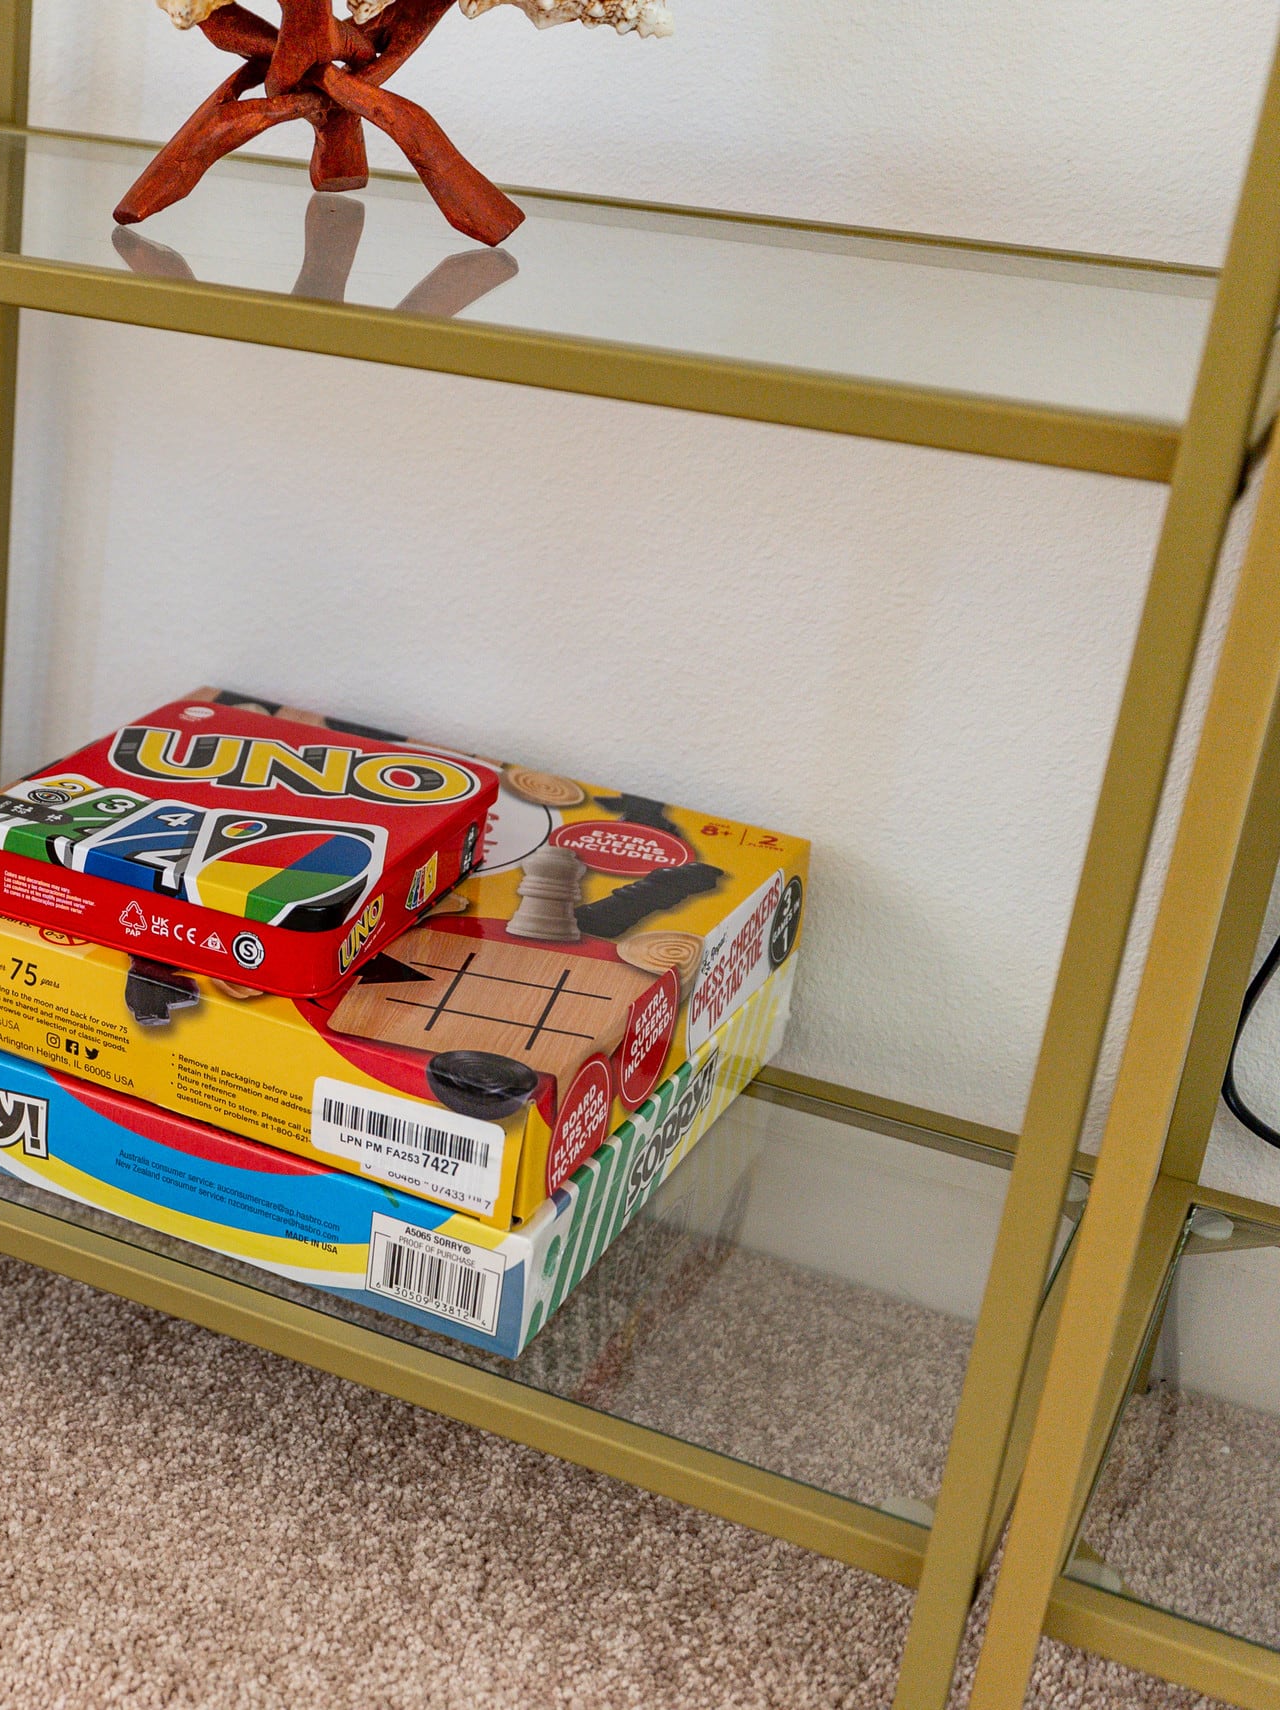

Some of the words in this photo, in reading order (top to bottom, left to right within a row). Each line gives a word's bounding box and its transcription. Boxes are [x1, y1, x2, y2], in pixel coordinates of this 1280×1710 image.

[107, 726, 481, 806] UNO
[579, 834, 666, 857] QUEENS
[590, 829, 659, 849] EXTRA
[700, 824, 733, 837] 8+
[757, 835, 779, 846] 2
[562, 838, 677, 865] INCLUDED!
[783, 886, 793, 917] 3
[125, 927, 141, 937] PAP
[151, 925, 169, 937] CA
[152, 915, 169, 928] UK
[339, 893, 384, 975] UNO
[772, 908, 793, 944] GAMES
[691, 877, 781, 1026] CHESS-CHECKERS
[10, 957, 38, 987] 75
[706, 928, 765, 1033] TIC-TAC-TOE
[2, 994, 14, 1005] are
[15, 998, 39, 1014] shared
[39, 1006, 53, 1018] and
[54, 1012, 95, 1033] memorable
[96, 1025, 130, 1045] moments
[20, 991, 32, 1002] the
[33, 997, 54, 1010] moon
[55, 1003, 69, 1015] and
[70, 1008, 87, 1021] back
[89, 1014, 100, 1025] for
[101, 1020, 117, 1031] over
[119, 1025, 128, 1034] 75
[630, 998, 669, 1057] QUEENS
[635, 986, 665, 1037] EXTRA
[22, 1012, 35, 1022] our
[36, 1016, 67, 1033] selection
[78, 1030, 101, 1045] classic
[102, 1037, 127, 1053] goods.
[624, 1006, 674, 1084] INCLUDED!
[36, 1046, 71, 1067] Heights,
[73, 1057, 82, 1069] IL
[84, 1062, 112, 1080] 60005
[113, 1073, 135, 1088] USA
[177, 1064, 202, 1077] Retain
[203, 1072, 217, 1084] this
[218, 1077, 263, 1098] information
[264, 1093, 279, 1104] and
[177, 1073, 200, 1086] future
[201, 1080, 237, 1099] reference
[178, 1054, 209, 1070] Remove
[210, 1063, 220, 1073] all
[220, 1069, 261, 1088] packaging
[262, 1082, 288, 1097] before
[289, 1091, 304, 1102] use
[176, 1082, 188, 1092] Do
[189, 1087, 202, 1097] not
[203, 1092, 227, 1105] return
[228, 1100, 237, 1109] to
[238, 1104, 259, 1117] store.
[261, 1111, 286, 1126] Please
[287, 1121, 302, 1131] call
[303, 1127, 312, 1136] us
[176, 1092, 213, 1110] questions
[213, 1104, 222, 1113] or
[223, 1108, 259, 1126] problems
[261, 1121, 269, 1130] at
[562, 1084, 597, 1139] BOARD
[339, 1132, 362, 1149] LPN
[365, 1140, 382, 1154] PM
[553, 1126, 583, 1169] FLIPS
[583, 1089, 604, 1127] FOR
[626, 1050, 719, 1212] SORRY!
[115, 1158, 132, 1171] New
[132, 1163, 161, 1182] Zealand
[161, 1173, 197, 1193] consumer
[198, 1184, 226, 1202] service:
[227, 1197, 340, 1242] nzconsumercare@hasbro.com
[118, 1149, 150, 1167] Australia
[151, 1161, 187, 1180] consumer
[188, 1171, 215, 1189] service:
[217, 1180, 341, 1233] auconsumercare@ap.hasbro.com
[483, 1200, 492, 1211] 7
[285, 1229, 309, 1245] MADE
[310, 1238, 320, 1249] IN
[320, 1241, 339, 1255] USA
[398, 1235, 424, 1250] PROOF
[425, 1244, 435, 1254] OF
[436, 1248, 476, 1268] PURCHASE
[404, 1226, 432, 1242] A5065
[394, 1286, 430, 1306] 30509
[434, 1301, 471, 1321] 93812
